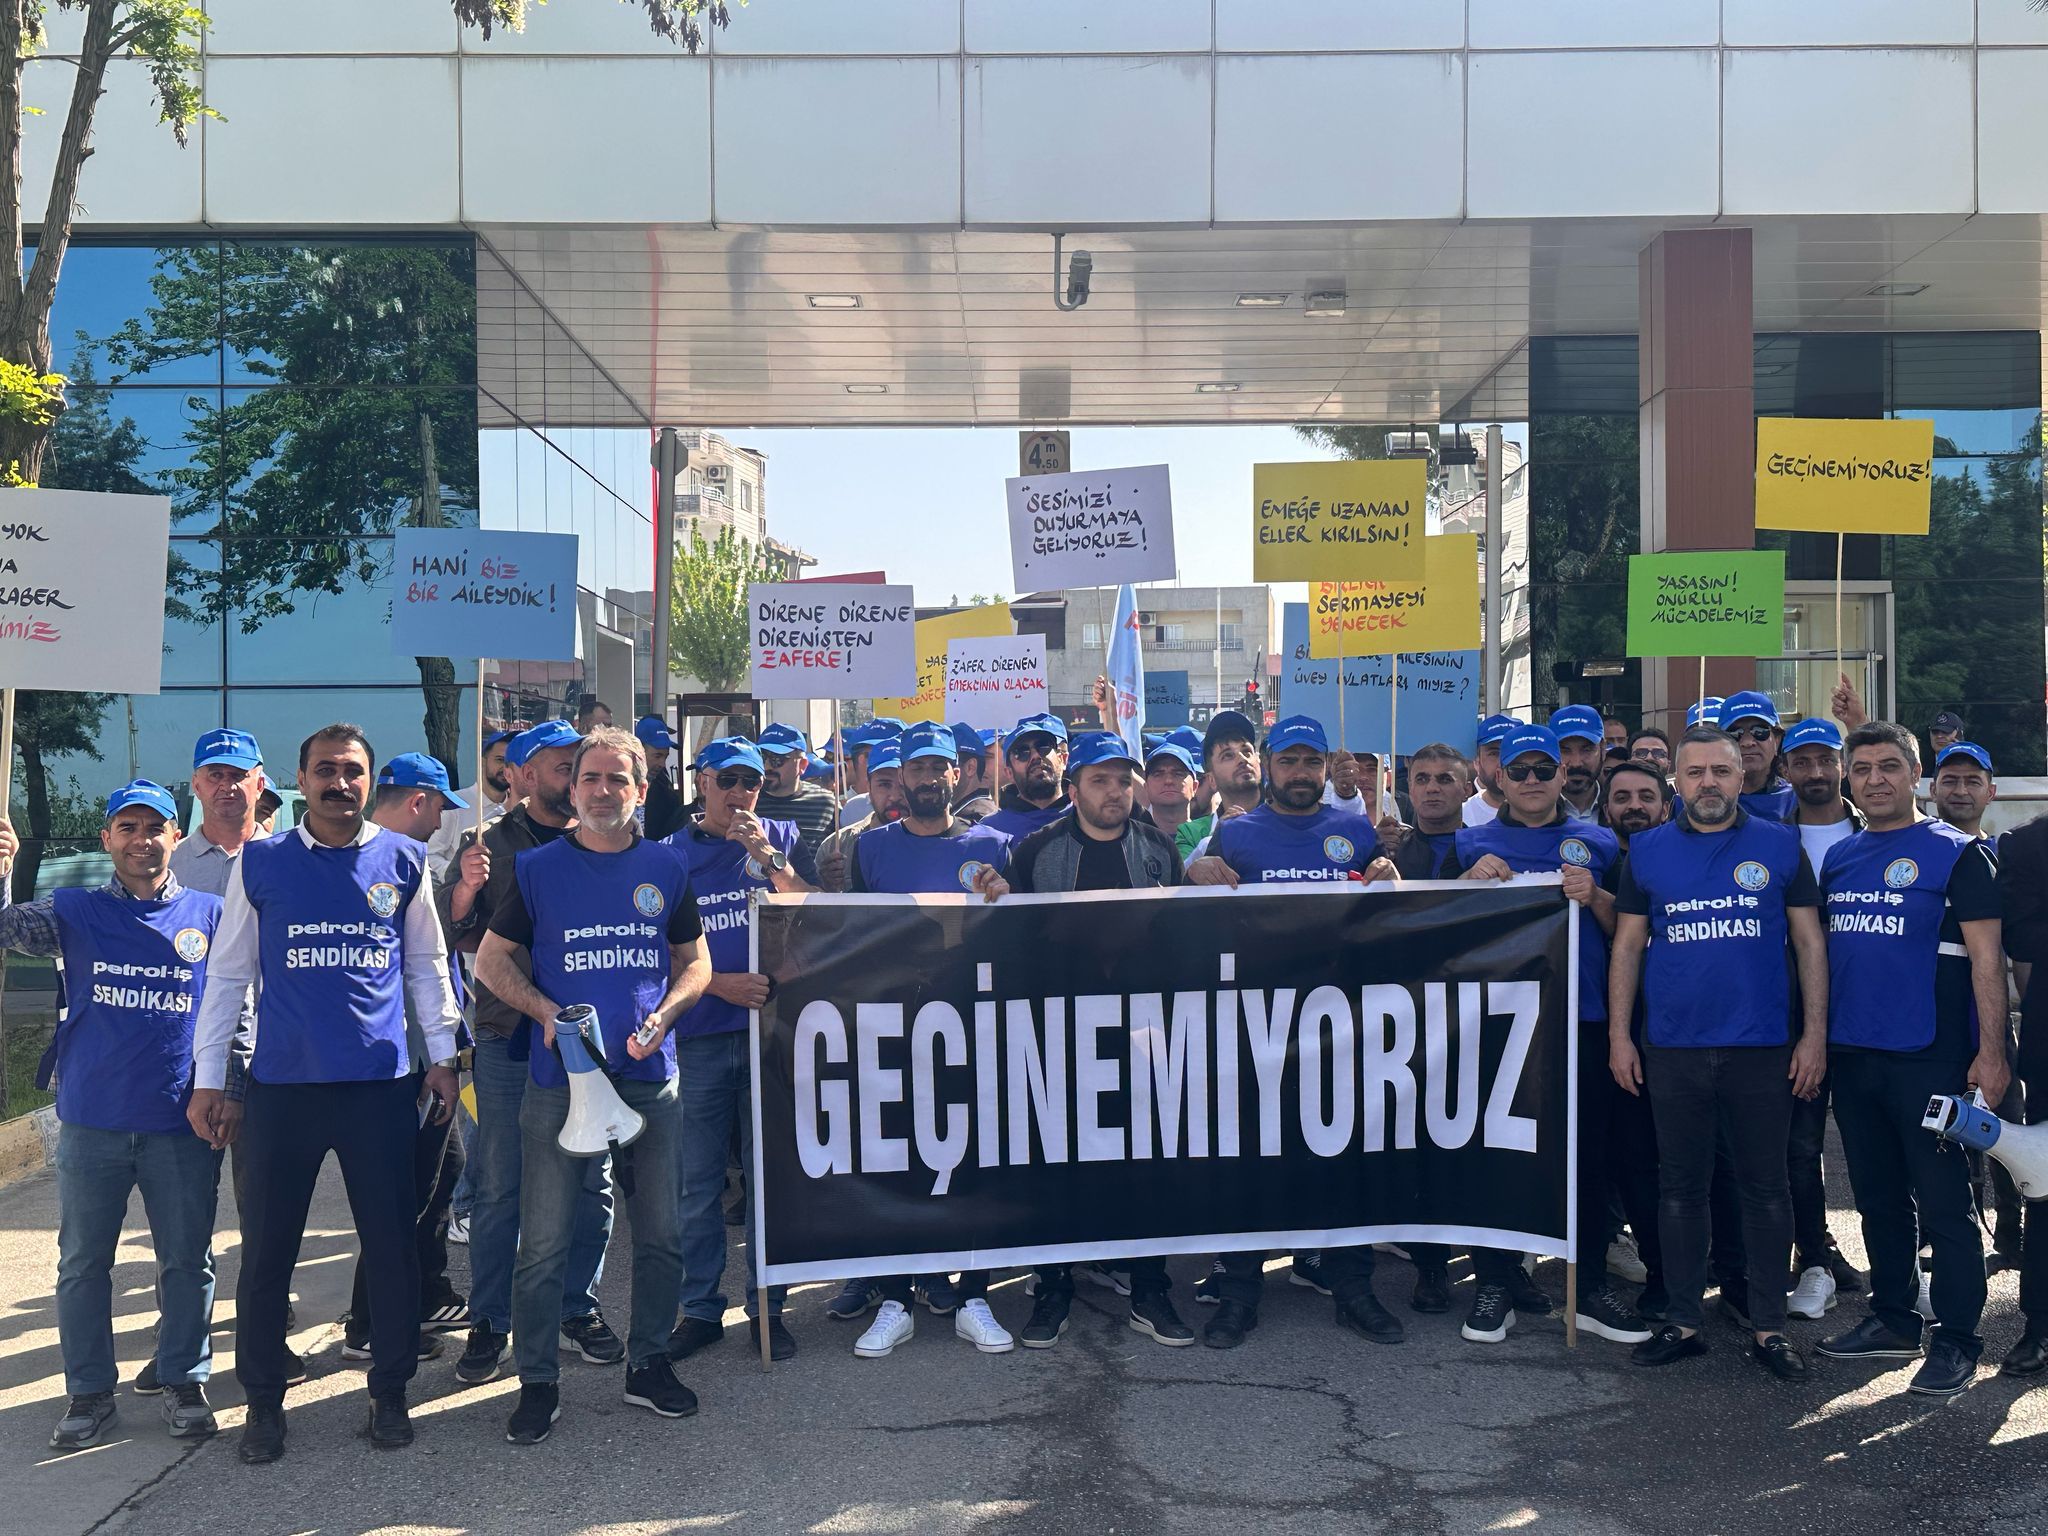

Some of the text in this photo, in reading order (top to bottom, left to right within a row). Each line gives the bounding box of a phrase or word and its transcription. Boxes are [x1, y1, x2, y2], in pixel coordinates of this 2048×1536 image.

[1767, 453, 1930, 482] GEÇİNEMİYORUZ!
[1026, 484, 1113, 513] SESİMİZİ
[1330, 500, 1410, 520] UZANAN
[1, 523, 50, 542] YOK
[1033, 509, 1143, 533] DUYURMAYA
[1259, 525, 1312, 544] ELLER
[412, 549, 521, 579] HANİ BİZ
[406, 580, 440, 602] BİR
[1317, 587, 1426, 614] SERMAYEYİ
[758, 599, 910, 623] DİRENE DİRENE
[1320, 612, 1409, 635] YENECEK
[758, 627, 873, 650] DİRENİŞTEN
[1664, 894, 1759, 916] petrol-iş
[564, 922, 658, 943] petrol-iş
[1667, 917, 1761, 943] SENDİKASI
[286, 942, 390, 969] SENDİKASI
[564, 944, 659, 973] SENDİKASI
[93, 961, 193, 982] petrol-iş
[92, 984, 193, 1013] SENDİKASI
[793, 952, 1541, 1196] GEÇİNEMİYORUZ
